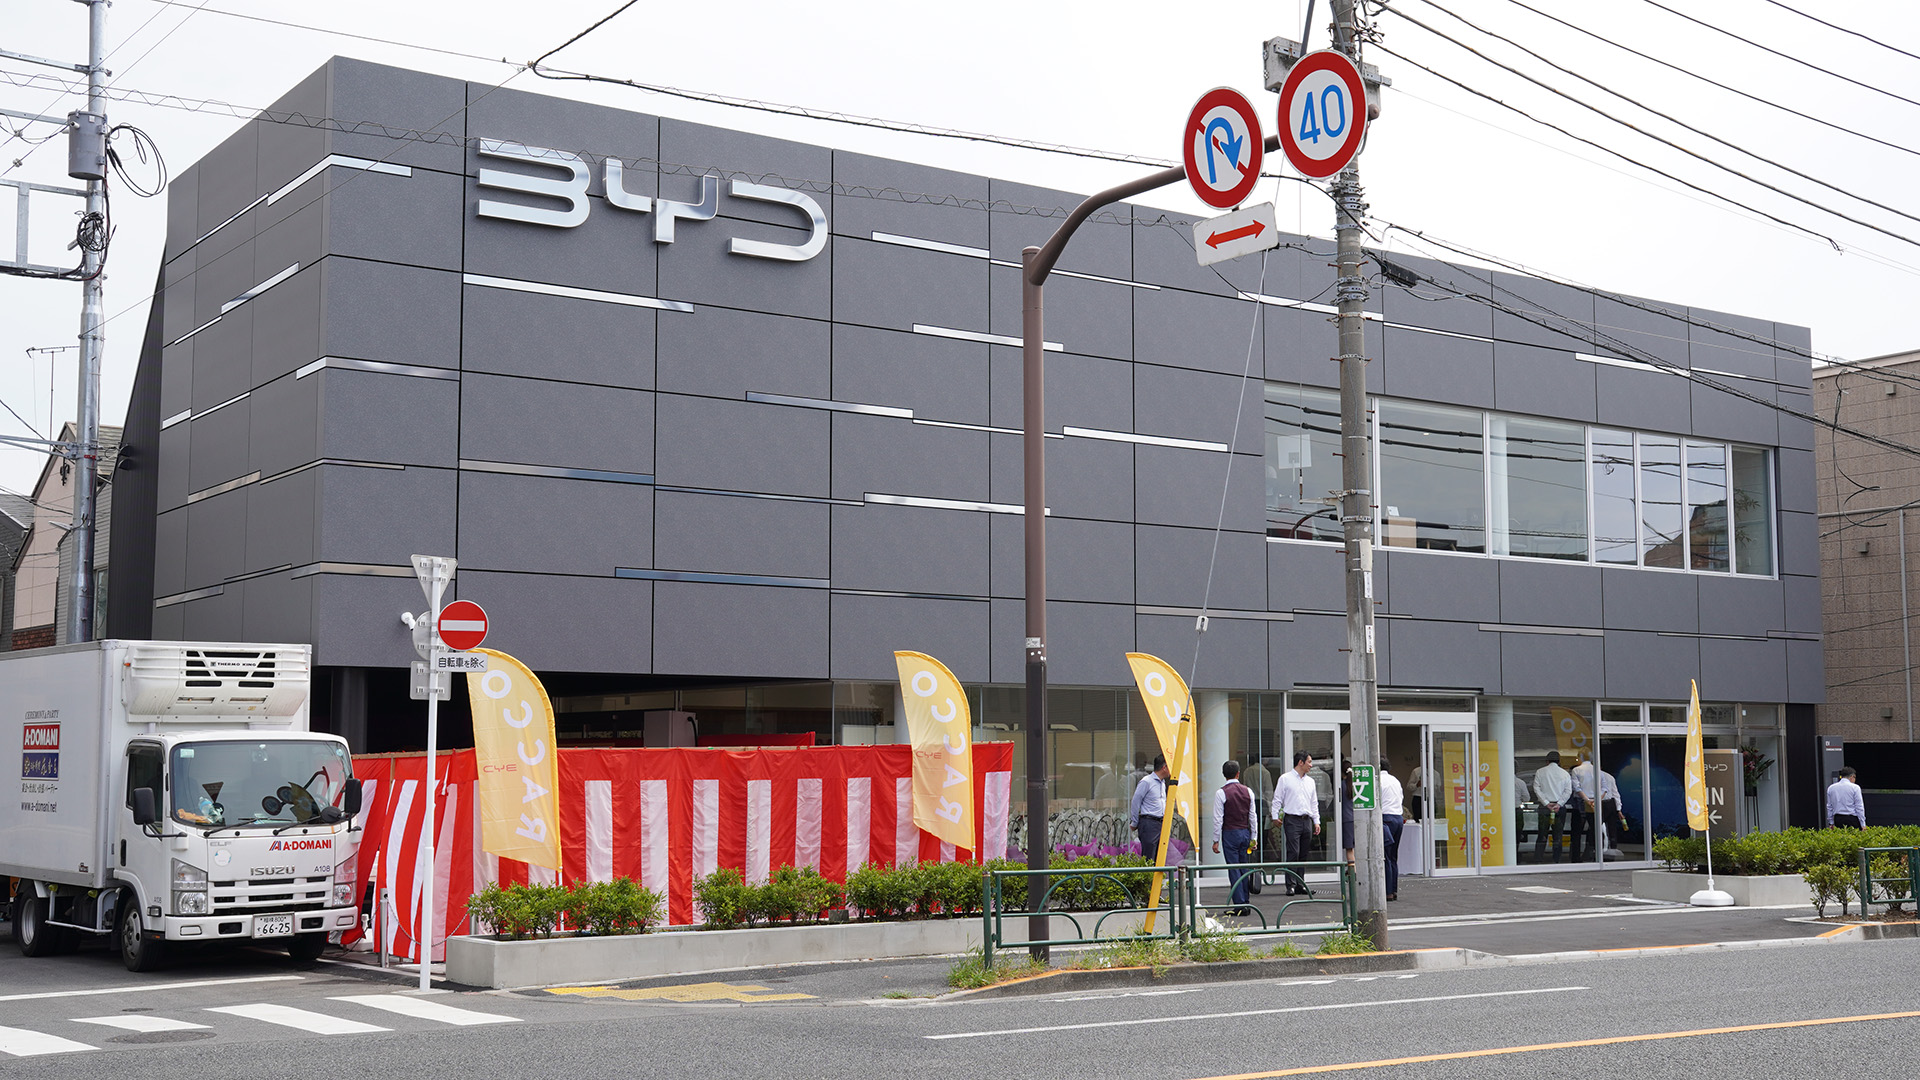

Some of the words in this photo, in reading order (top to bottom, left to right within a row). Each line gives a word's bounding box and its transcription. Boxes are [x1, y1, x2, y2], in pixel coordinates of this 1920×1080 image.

[1300, 84, 1345, 144] 40
[477, 137, 828, 262] BYD
[438, 657, 485, 668] 自転車を除く
[1706, 786, 1724, 806] IN
[250, 866, 296, 876] ISUZU
[314, 864, 331, 873] A108
